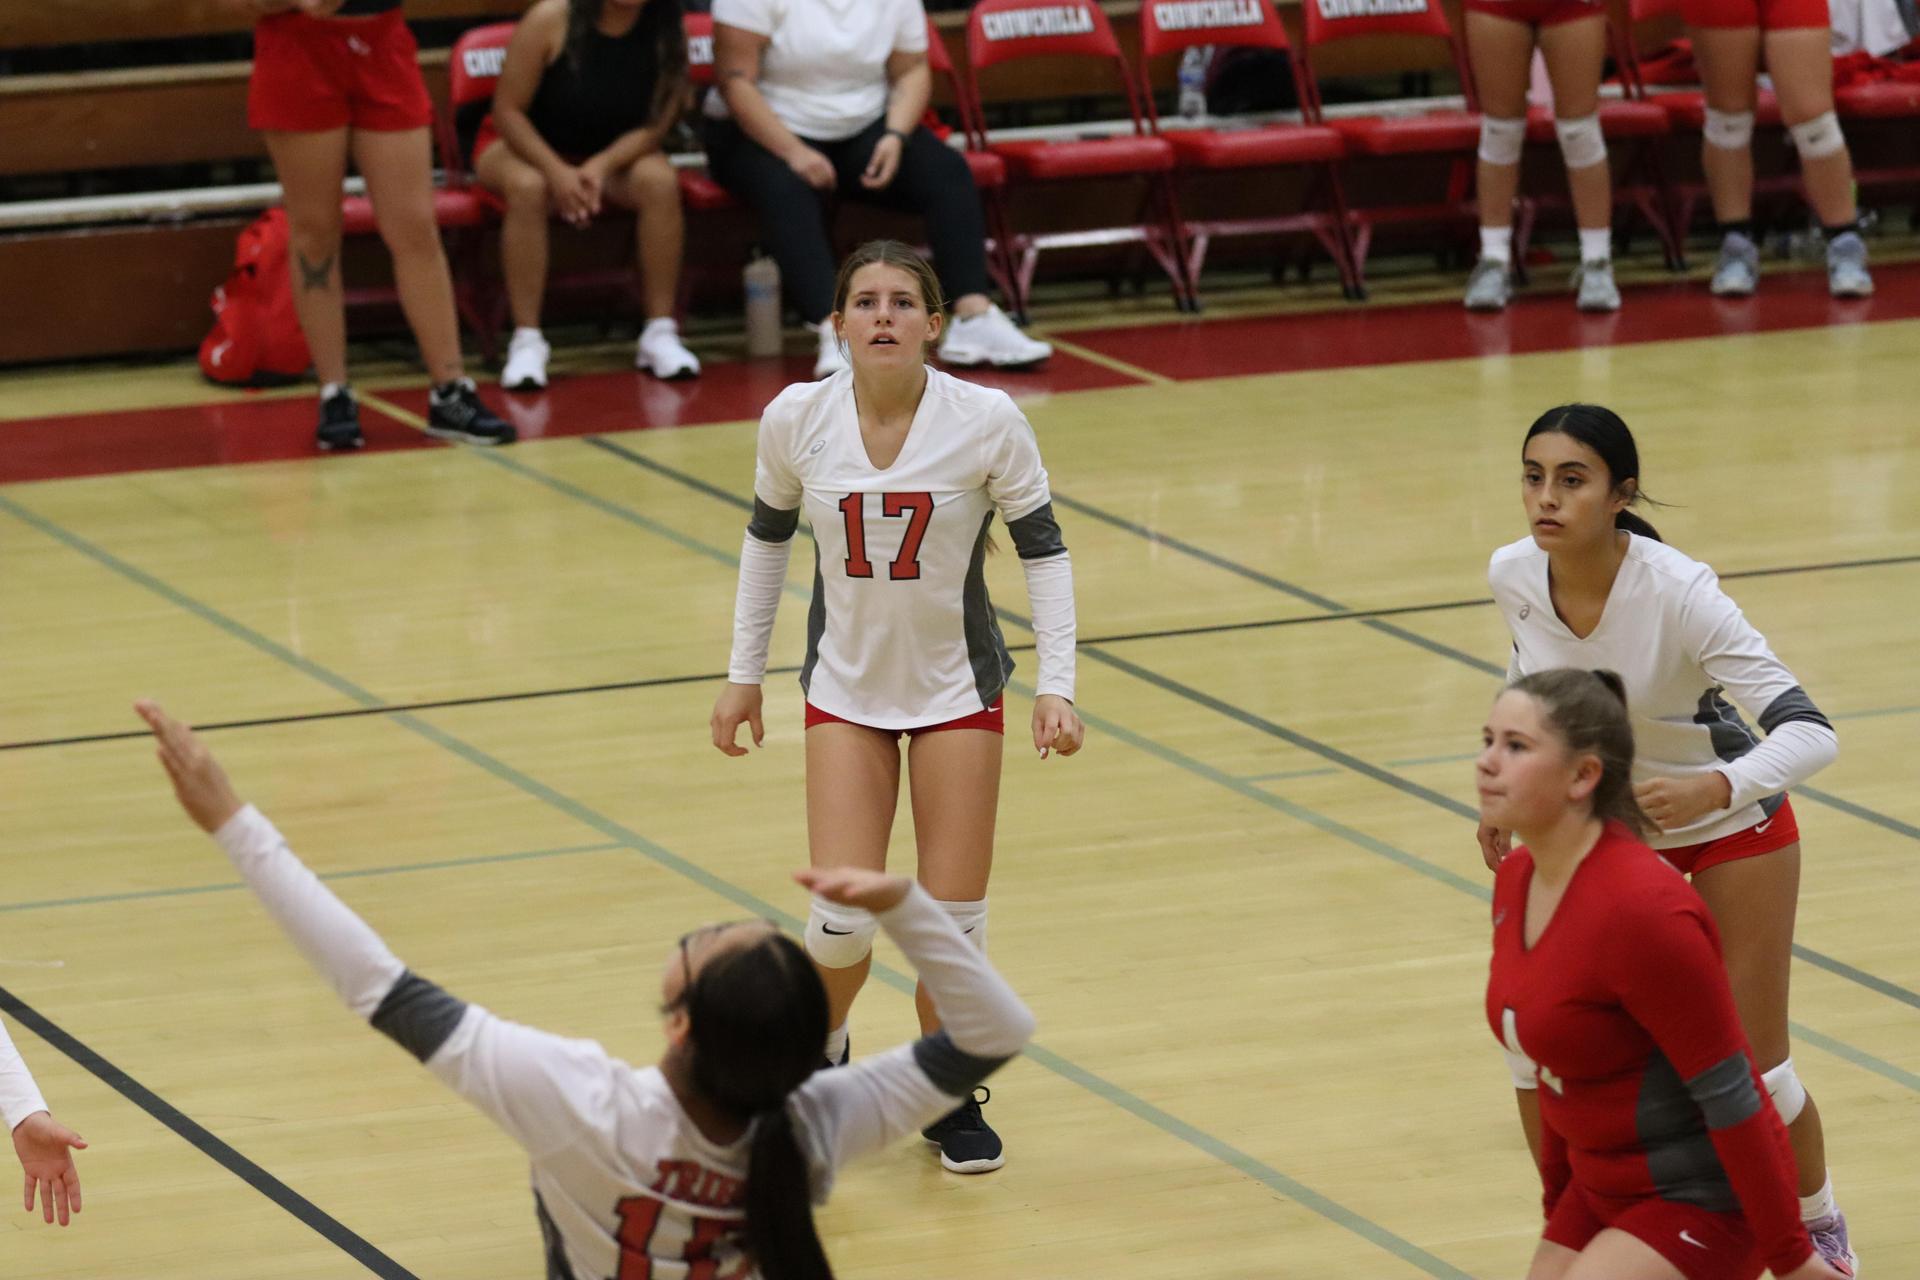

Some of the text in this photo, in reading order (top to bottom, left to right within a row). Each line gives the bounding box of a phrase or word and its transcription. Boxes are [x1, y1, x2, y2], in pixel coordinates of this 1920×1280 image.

[981, 6, 1096, 41] CHOWCHILLA
[1153, 0, 1264, 31] CHOWCHILLA
[838, 491, 935, 581] 17
